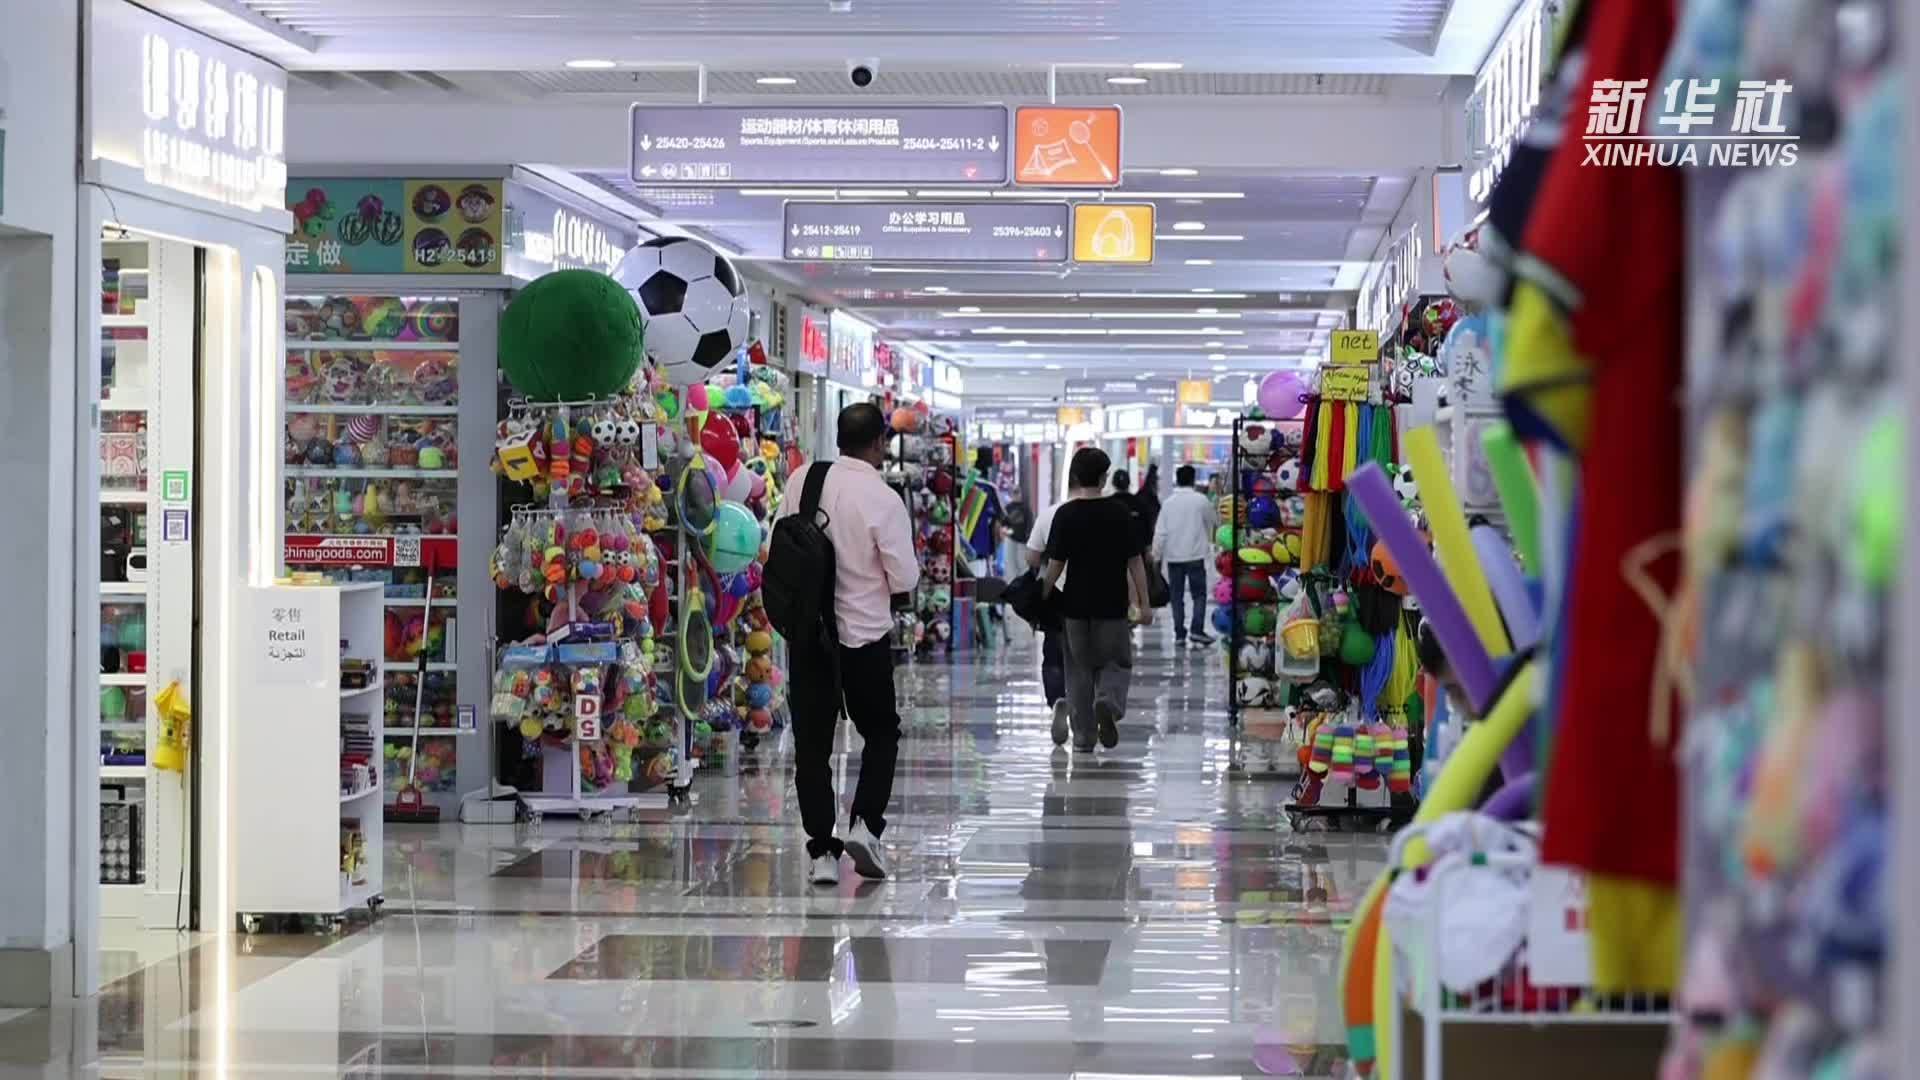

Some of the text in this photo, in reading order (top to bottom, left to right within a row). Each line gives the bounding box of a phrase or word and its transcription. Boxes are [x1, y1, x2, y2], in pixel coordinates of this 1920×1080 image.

[741, 118, 900, 135] 运动器材/体育休闲用品
[656, 136, 725, 149] 25420-25426
[903, 138, 984, 150] 25404-25411-2
[889, 211, 966, 225] 办公学习用品
[802, 225, 861, 236] 25412-25419
[1341, 334, 1372, 350] net
[271, 607, 302, 623] 零售
[268, 629, 305, 641] Retail
